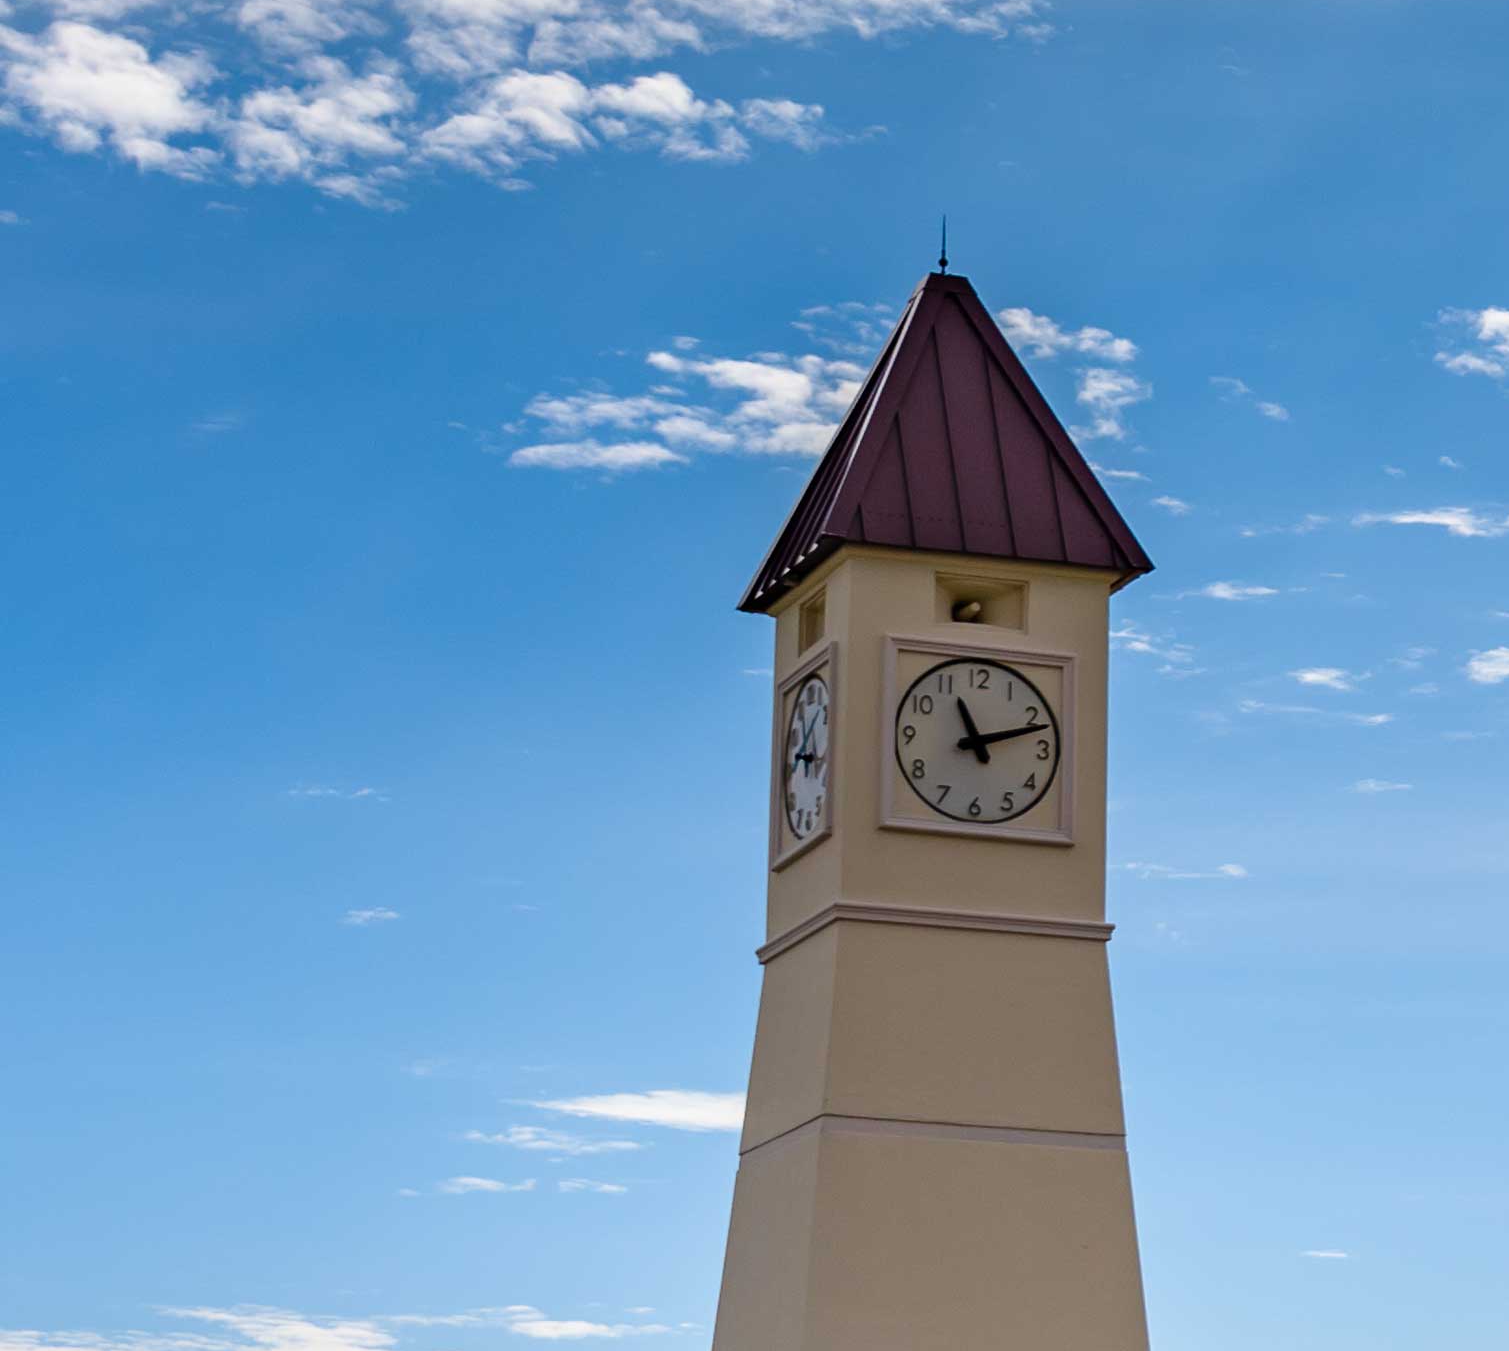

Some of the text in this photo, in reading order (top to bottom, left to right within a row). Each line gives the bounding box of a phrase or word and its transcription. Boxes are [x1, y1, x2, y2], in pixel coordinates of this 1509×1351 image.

[938, 674, 953, 695] 11
[969, 669, 991, 690] 12
[1007, 680, 1013, 702] 1
[912, 694, 934, 715] 10
[1025, 706, 1039, 726] 2
[902, 725, 917, 746] 9
[1036, 739, 1050, 761] 3
[911, 759, 926, 780] 8
[1022, 771, 1037, 792] 4
[936, 785, 952, 806] 7
[1000, 792, 1015, 813] 5
[968, 797, 982, 818] 6
